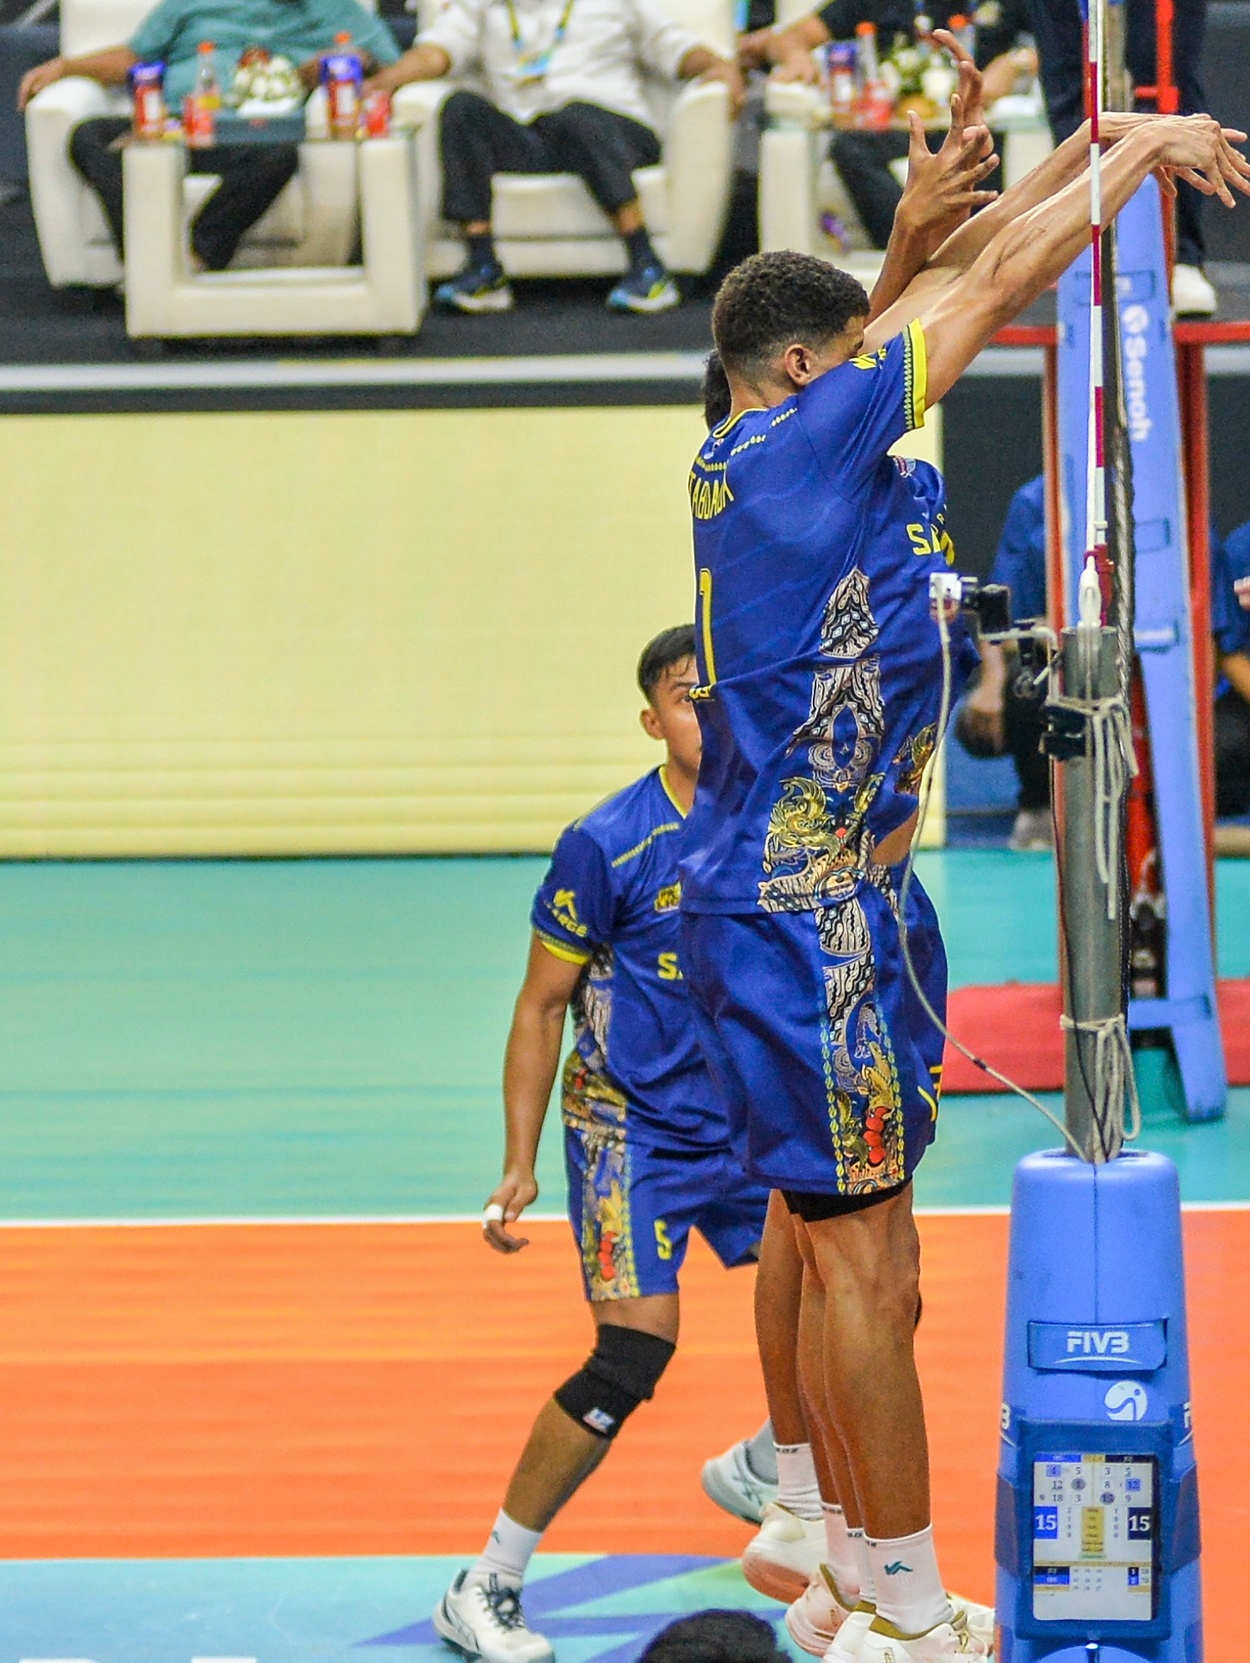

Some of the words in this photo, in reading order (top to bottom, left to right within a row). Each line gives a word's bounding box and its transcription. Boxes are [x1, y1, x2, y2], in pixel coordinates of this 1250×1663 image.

[1066, 1331, 1129, 1353] FIVB
[1052, 1480, 1063, 1490] 12
[1052, 1494, 1063, 1502] 18
[1035, 1514, 1057, 1531] 15
[1128, 1515, 1151, 1532] 15
